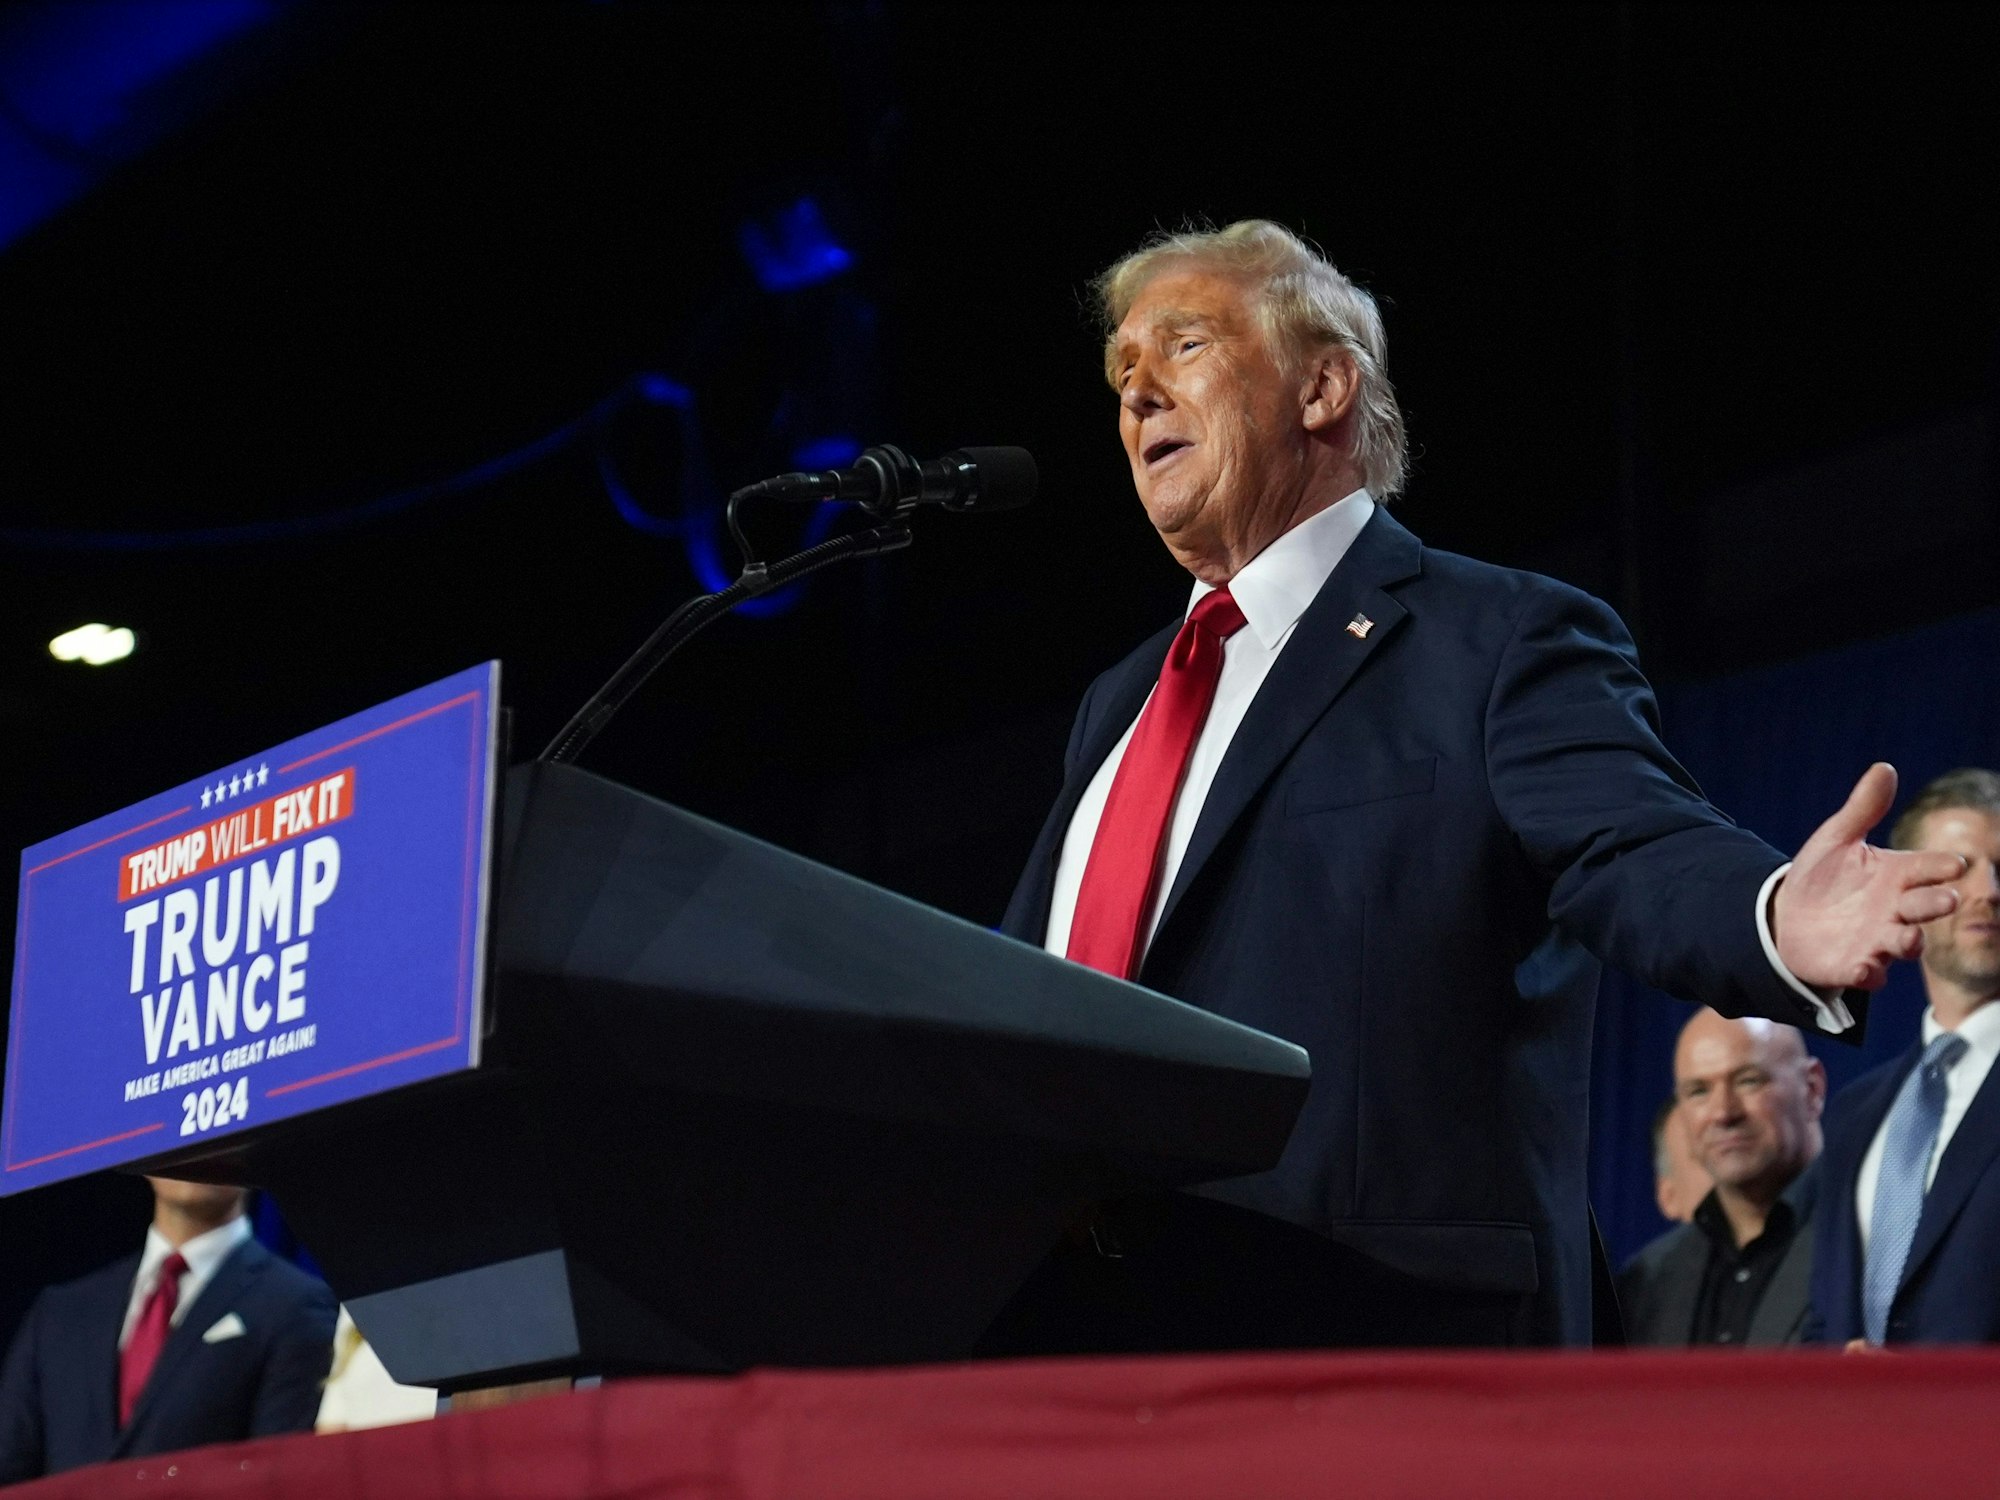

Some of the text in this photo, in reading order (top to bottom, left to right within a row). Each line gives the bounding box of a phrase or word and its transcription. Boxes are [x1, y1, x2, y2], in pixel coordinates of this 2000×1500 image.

[128, 774, 345, 895] TRUMP WILL FIX IT
[124, 835, 341, 994] TRUMP
[125, 1023, 317, 1102] MAKE AMERICA GREAT AGAIN!
[141, 940, 309, 1065] VANCE
[180, 1076, 249, 1137] 2024
